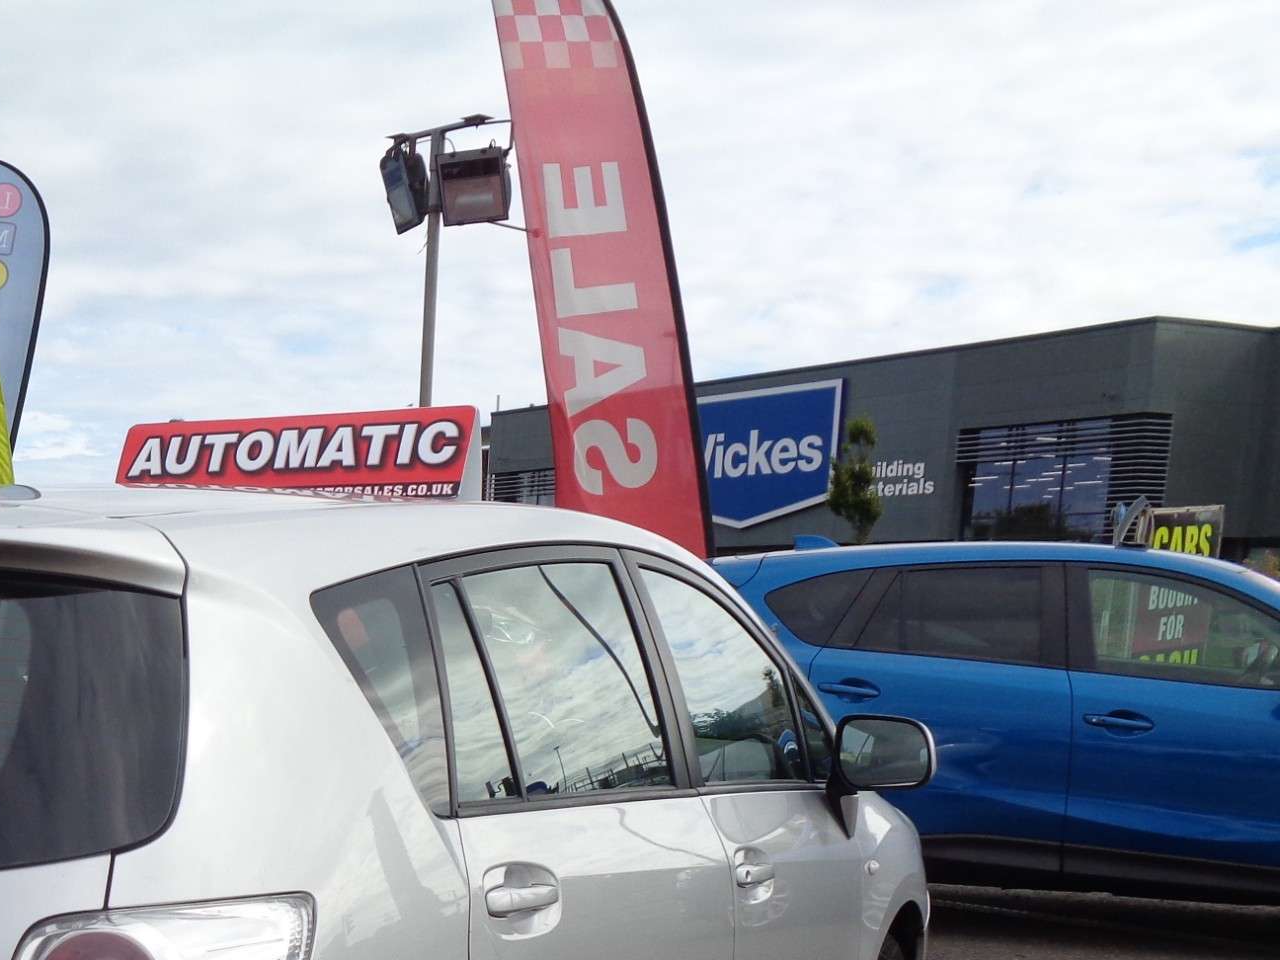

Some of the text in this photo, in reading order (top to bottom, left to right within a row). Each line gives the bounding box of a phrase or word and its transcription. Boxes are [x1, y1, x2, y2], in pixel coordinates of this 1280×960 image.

[128, 420, 460, 478] AUTOMATIC
[704, 430, 823, 479] ickes
[871, 460, 926, 479] ilding
[868, 478, 935, 497] aterials
[1153, 523, 1213, 558] CARS
[1157, 614, 1185, 641] FOR
